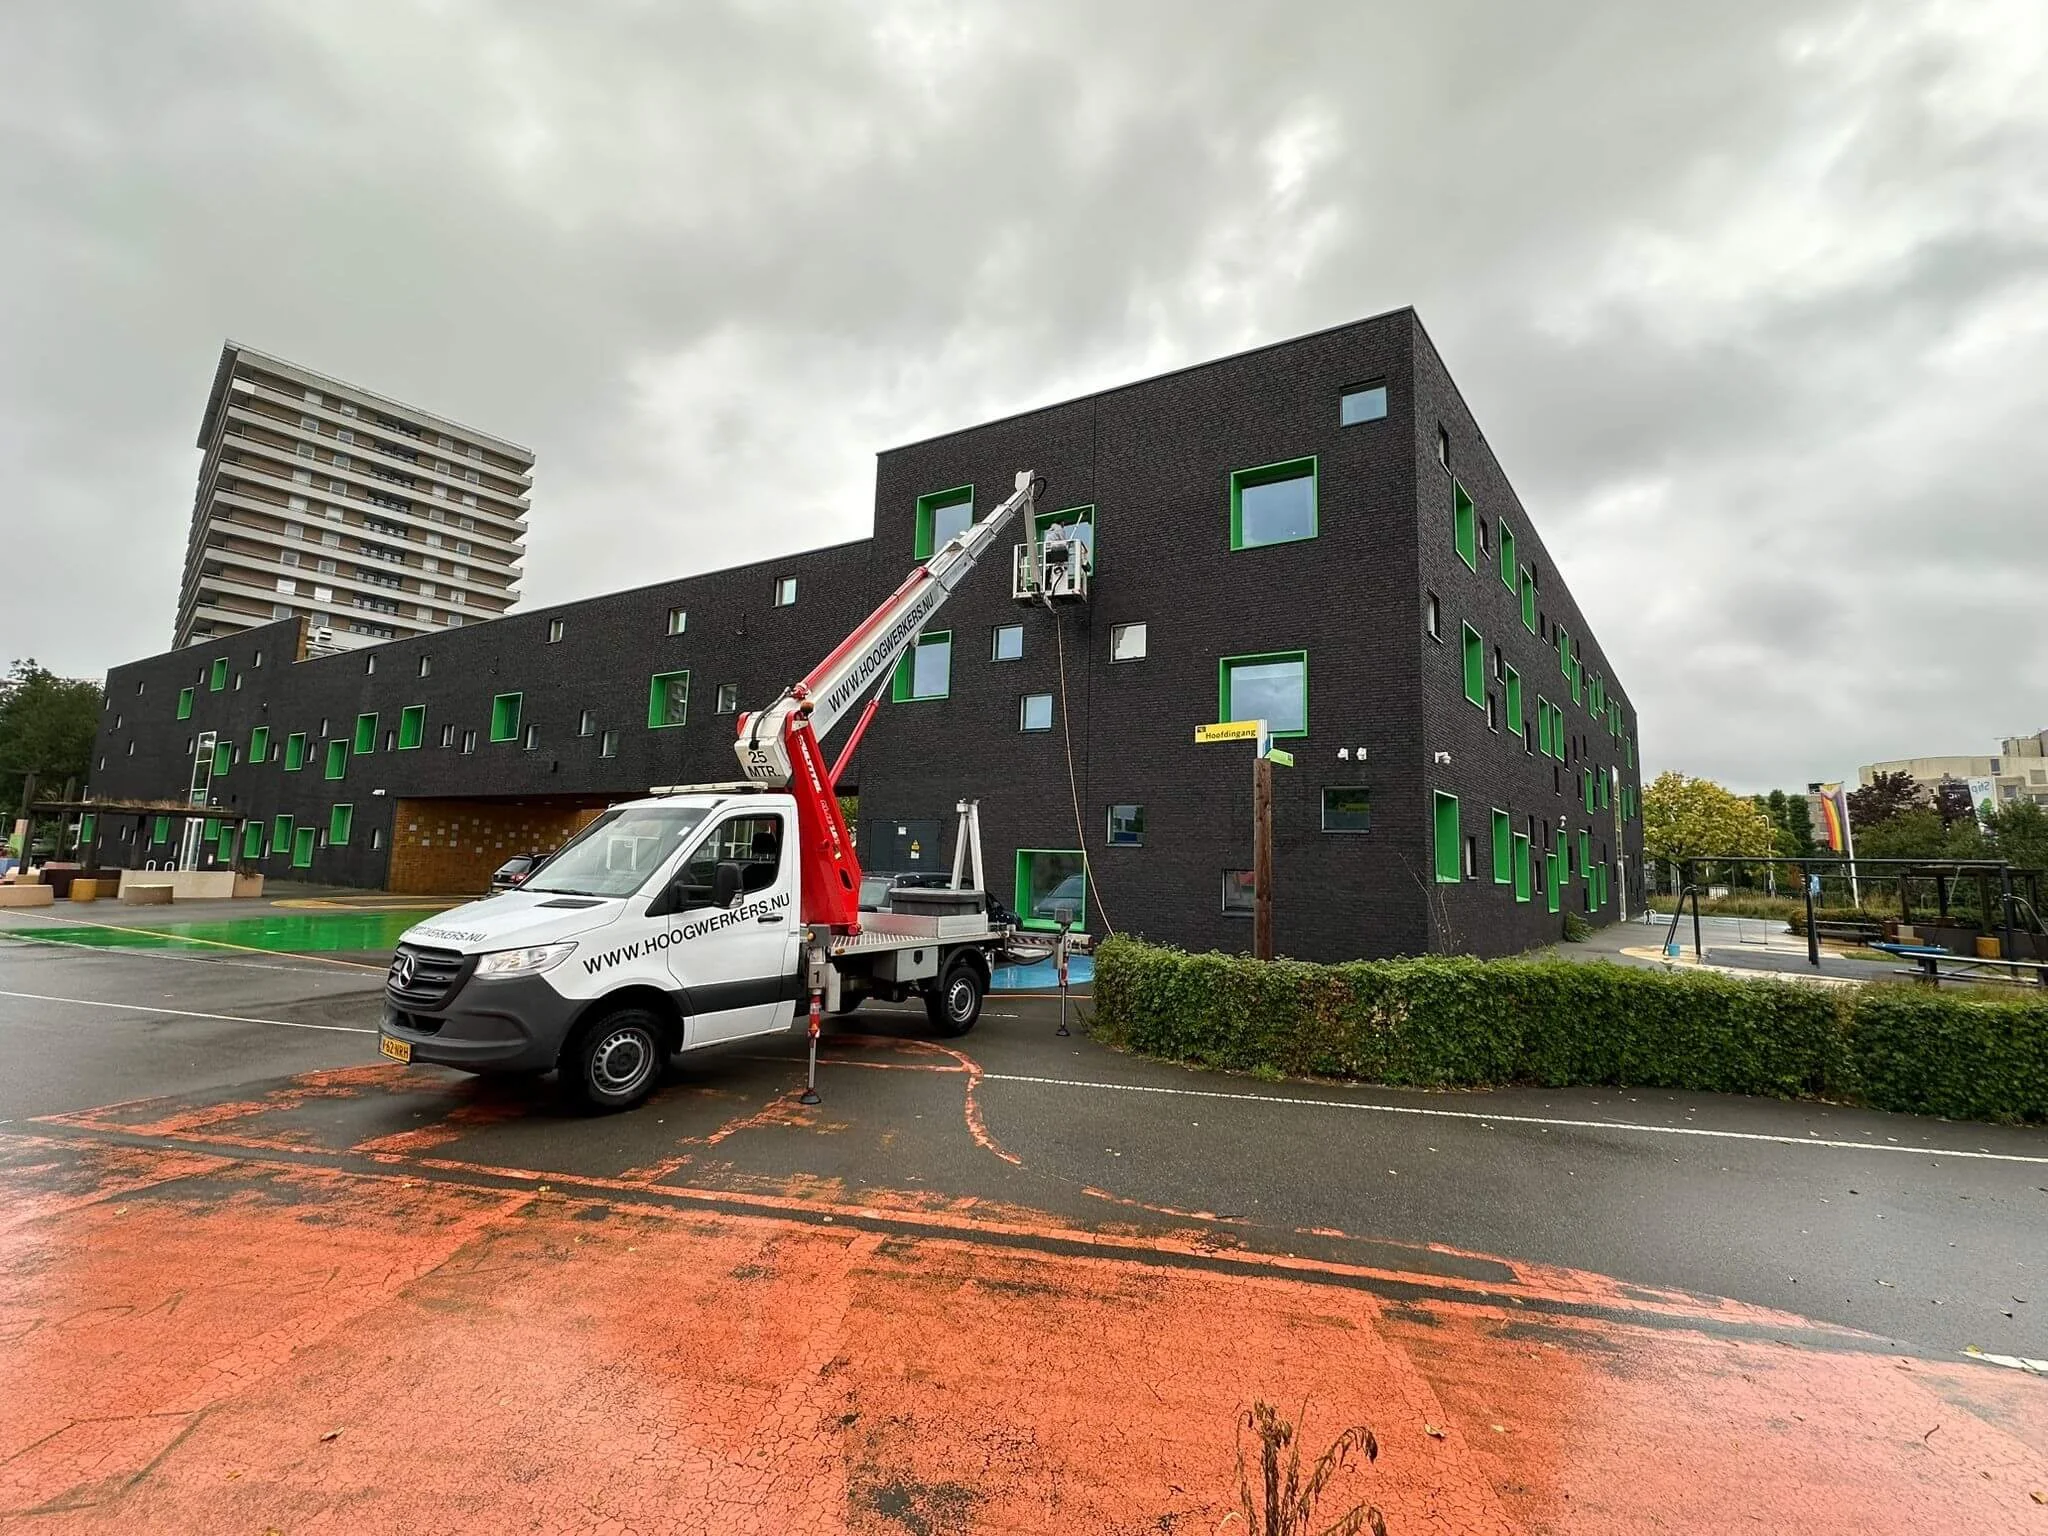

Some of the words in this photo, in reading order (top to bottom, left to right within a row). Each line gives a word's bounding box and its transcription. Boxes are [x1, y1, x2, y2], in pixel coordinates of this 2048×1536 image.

[828, 592, 934, 713] WWW.HOOGWERKERS.NU
[1205, 729, 1257, 740] Hoofdingang
[748, 750, 768, 764] 25
[583, 892, 790, 975] WWW.HOOGWERKERS.NU
[813, 970, 821, 984] 1
